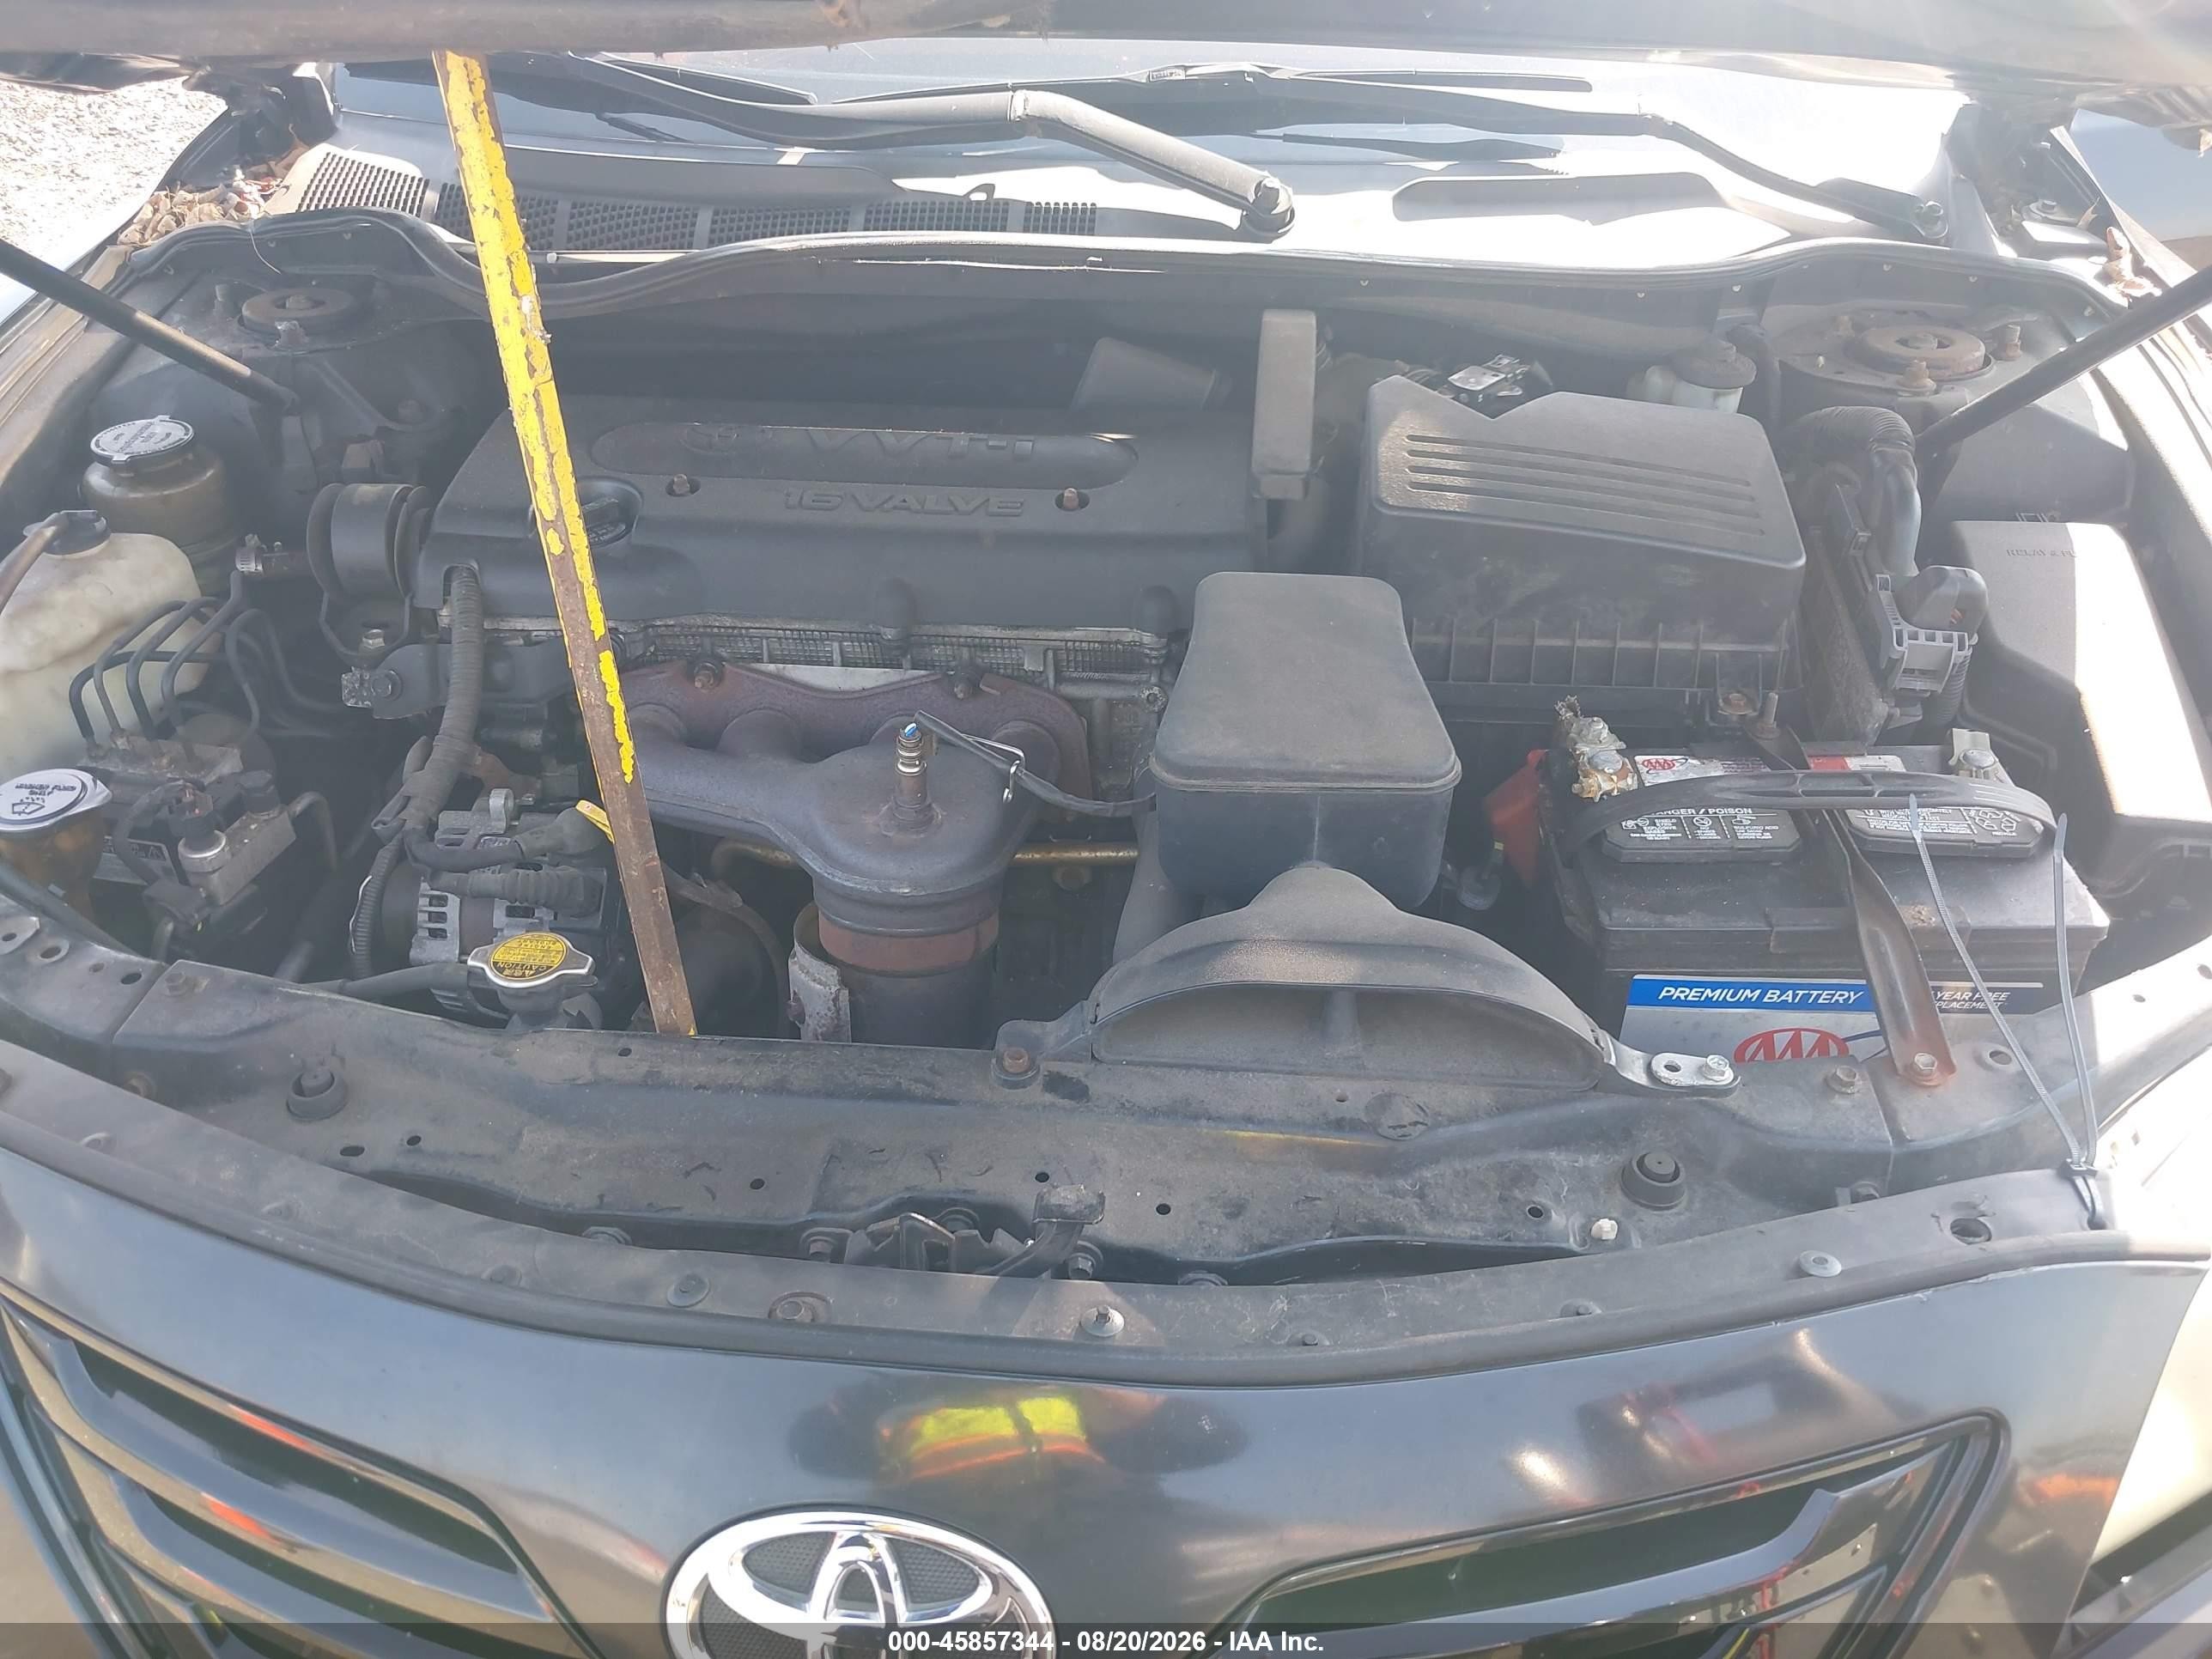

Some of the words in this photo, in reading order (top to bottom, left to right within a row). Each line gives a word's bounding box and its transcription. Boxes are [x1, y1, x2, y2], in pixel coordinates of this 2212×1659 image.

[497, 961, 547, 972] CAUTION
[1658, 987, 1761, 1003] PREMIUM
[1763, 989, 1863, 1004] BATTERY
[1936, 991, 1972, 1001] YEAR
